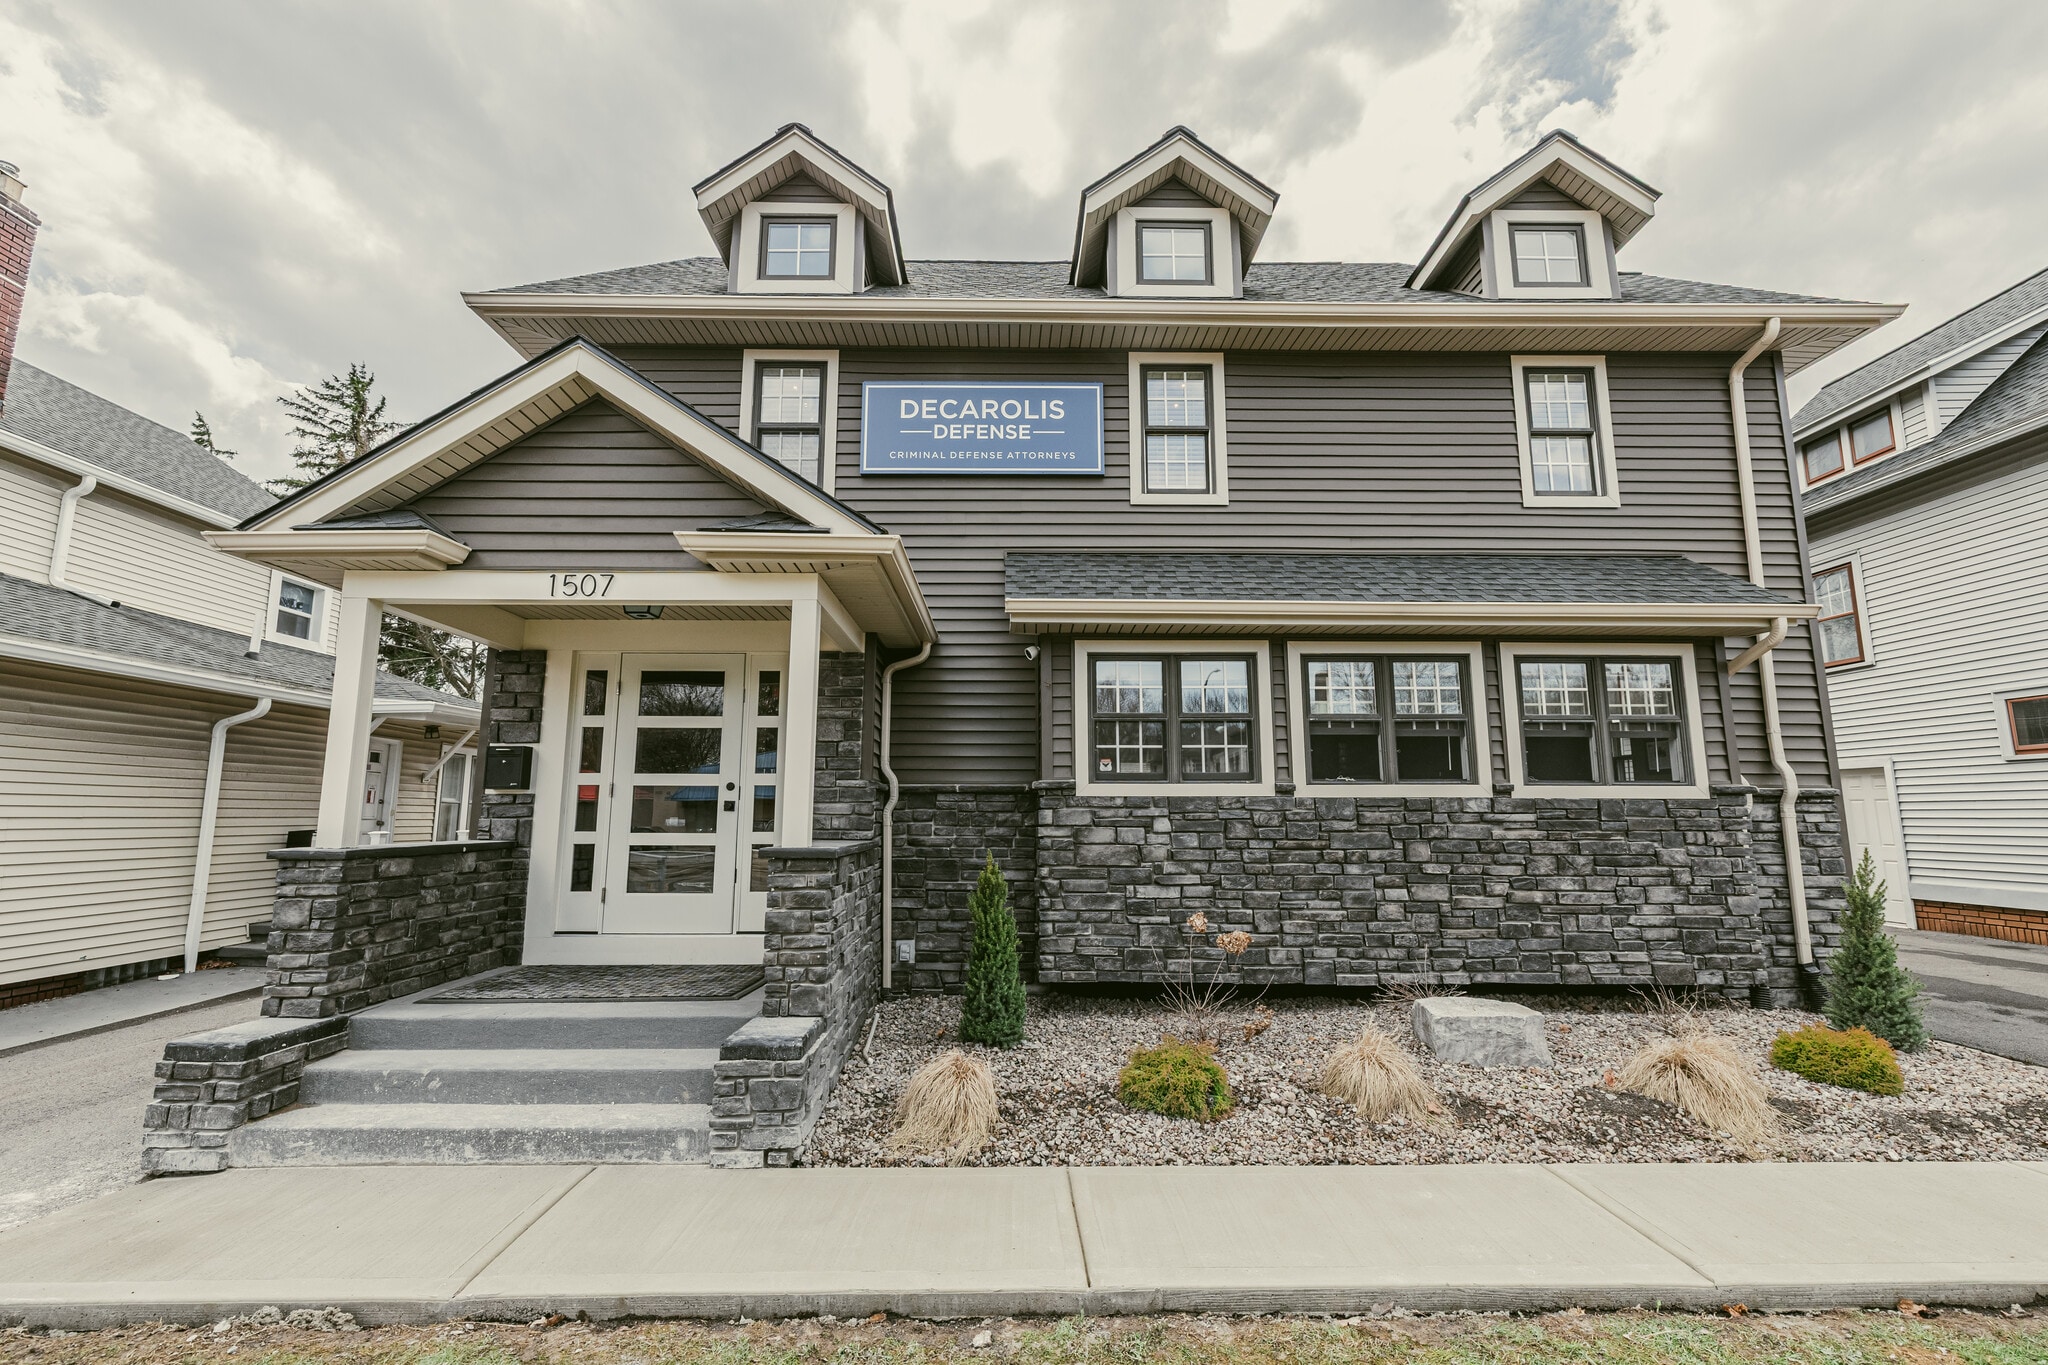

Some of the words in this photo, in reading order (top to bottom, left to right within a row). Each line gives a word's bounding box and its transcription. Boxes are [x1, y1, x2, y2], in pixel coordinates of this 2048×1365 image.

[900, 399, 1065, 420] DECAROLIS
[933, 424, 1031, 440] DEFENSE
[889, 450, 947, 460] CRIMINAL
[949, 450, 1003, 460] DEFENSE
[1006, 450, 1076, 460] ATTORNEYS
[549, 573, 615, 597] 1507
